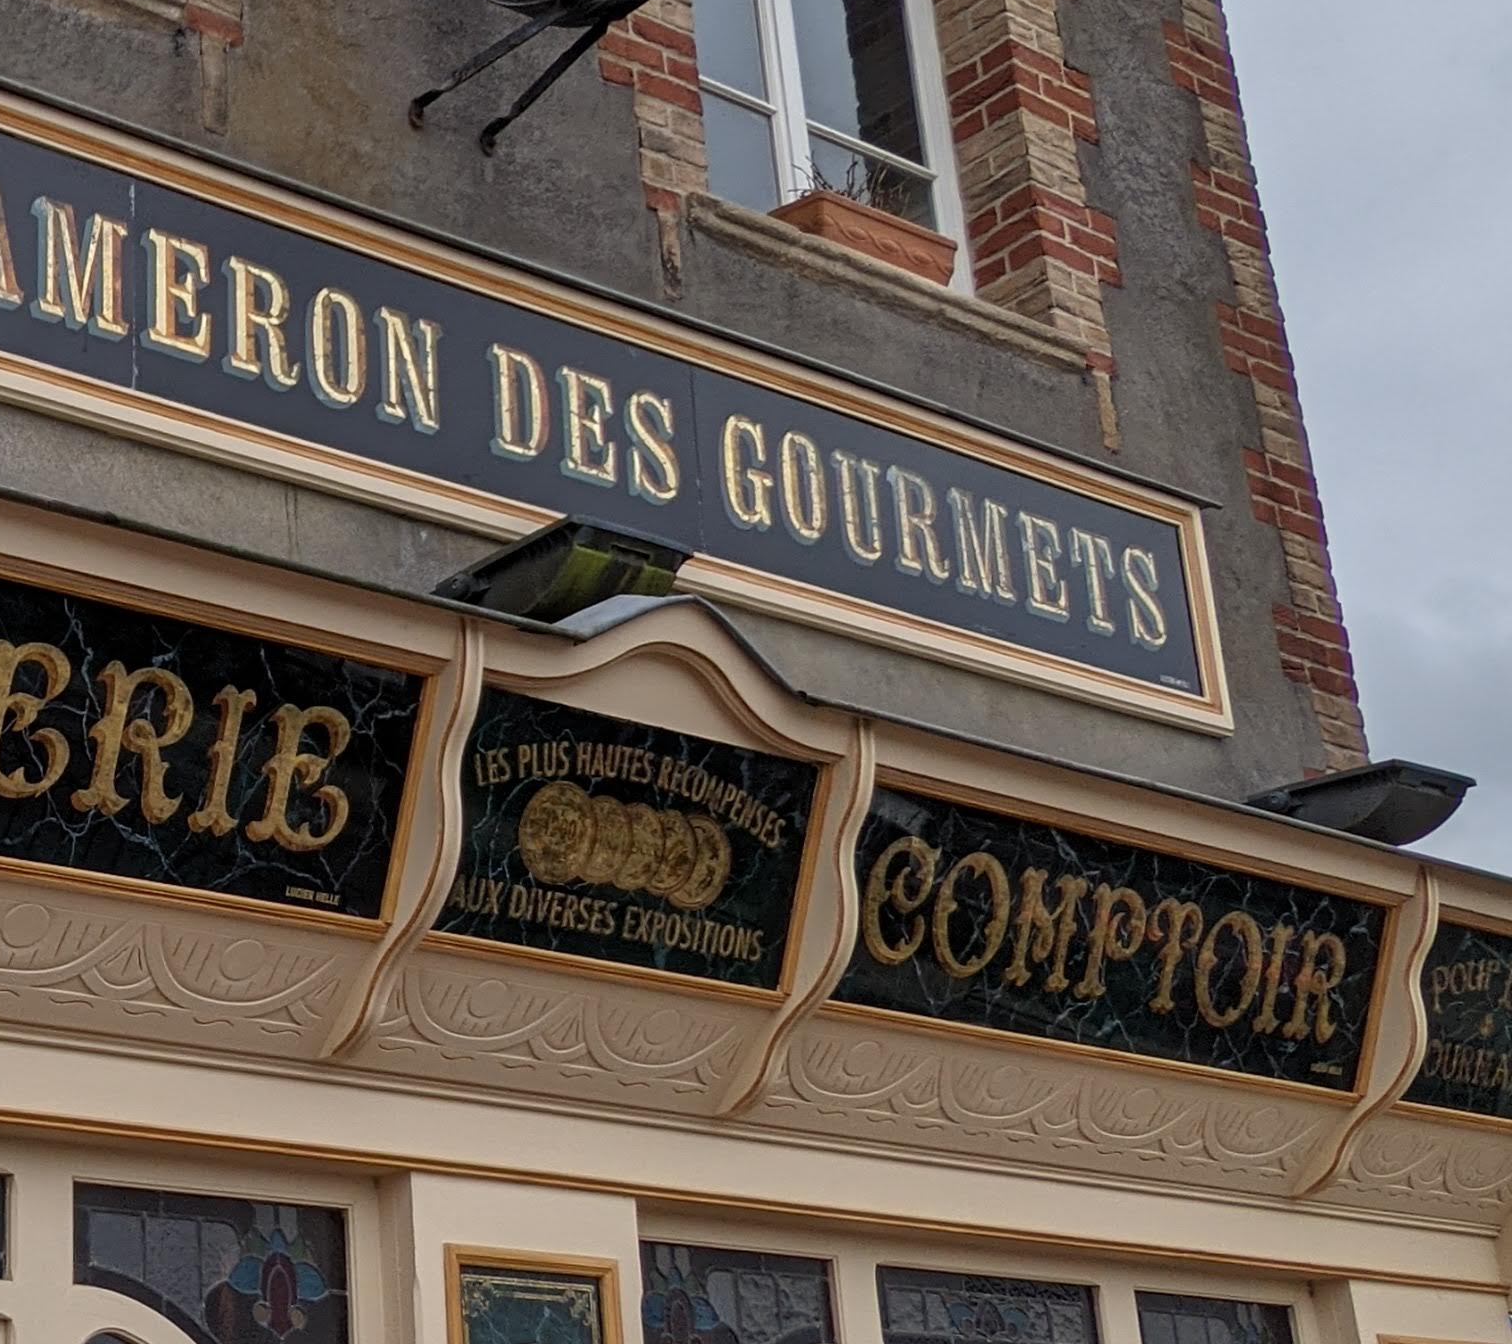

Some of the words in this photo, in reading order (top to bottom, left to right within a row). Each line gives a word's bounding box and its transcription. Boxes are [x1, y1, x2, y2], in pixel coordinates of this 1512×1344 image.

[487, 342, 680, 505] DES
[719, 414, 1169, 651] GOURMETS
[475, 748, 511, 787] LES
[519, 741, 570, 779] PLUS
[577, 742, 654, 783] HAUTES
[657, 756, 786, 848] RECOMPENSES
[451, 875, 500, 914] AUX
[508, 883, 617, 935] DIVERSES
[623, 905, 765, 961] EXPOSITIONS
[863, 836, 1346, 1043] COMPTOIR
